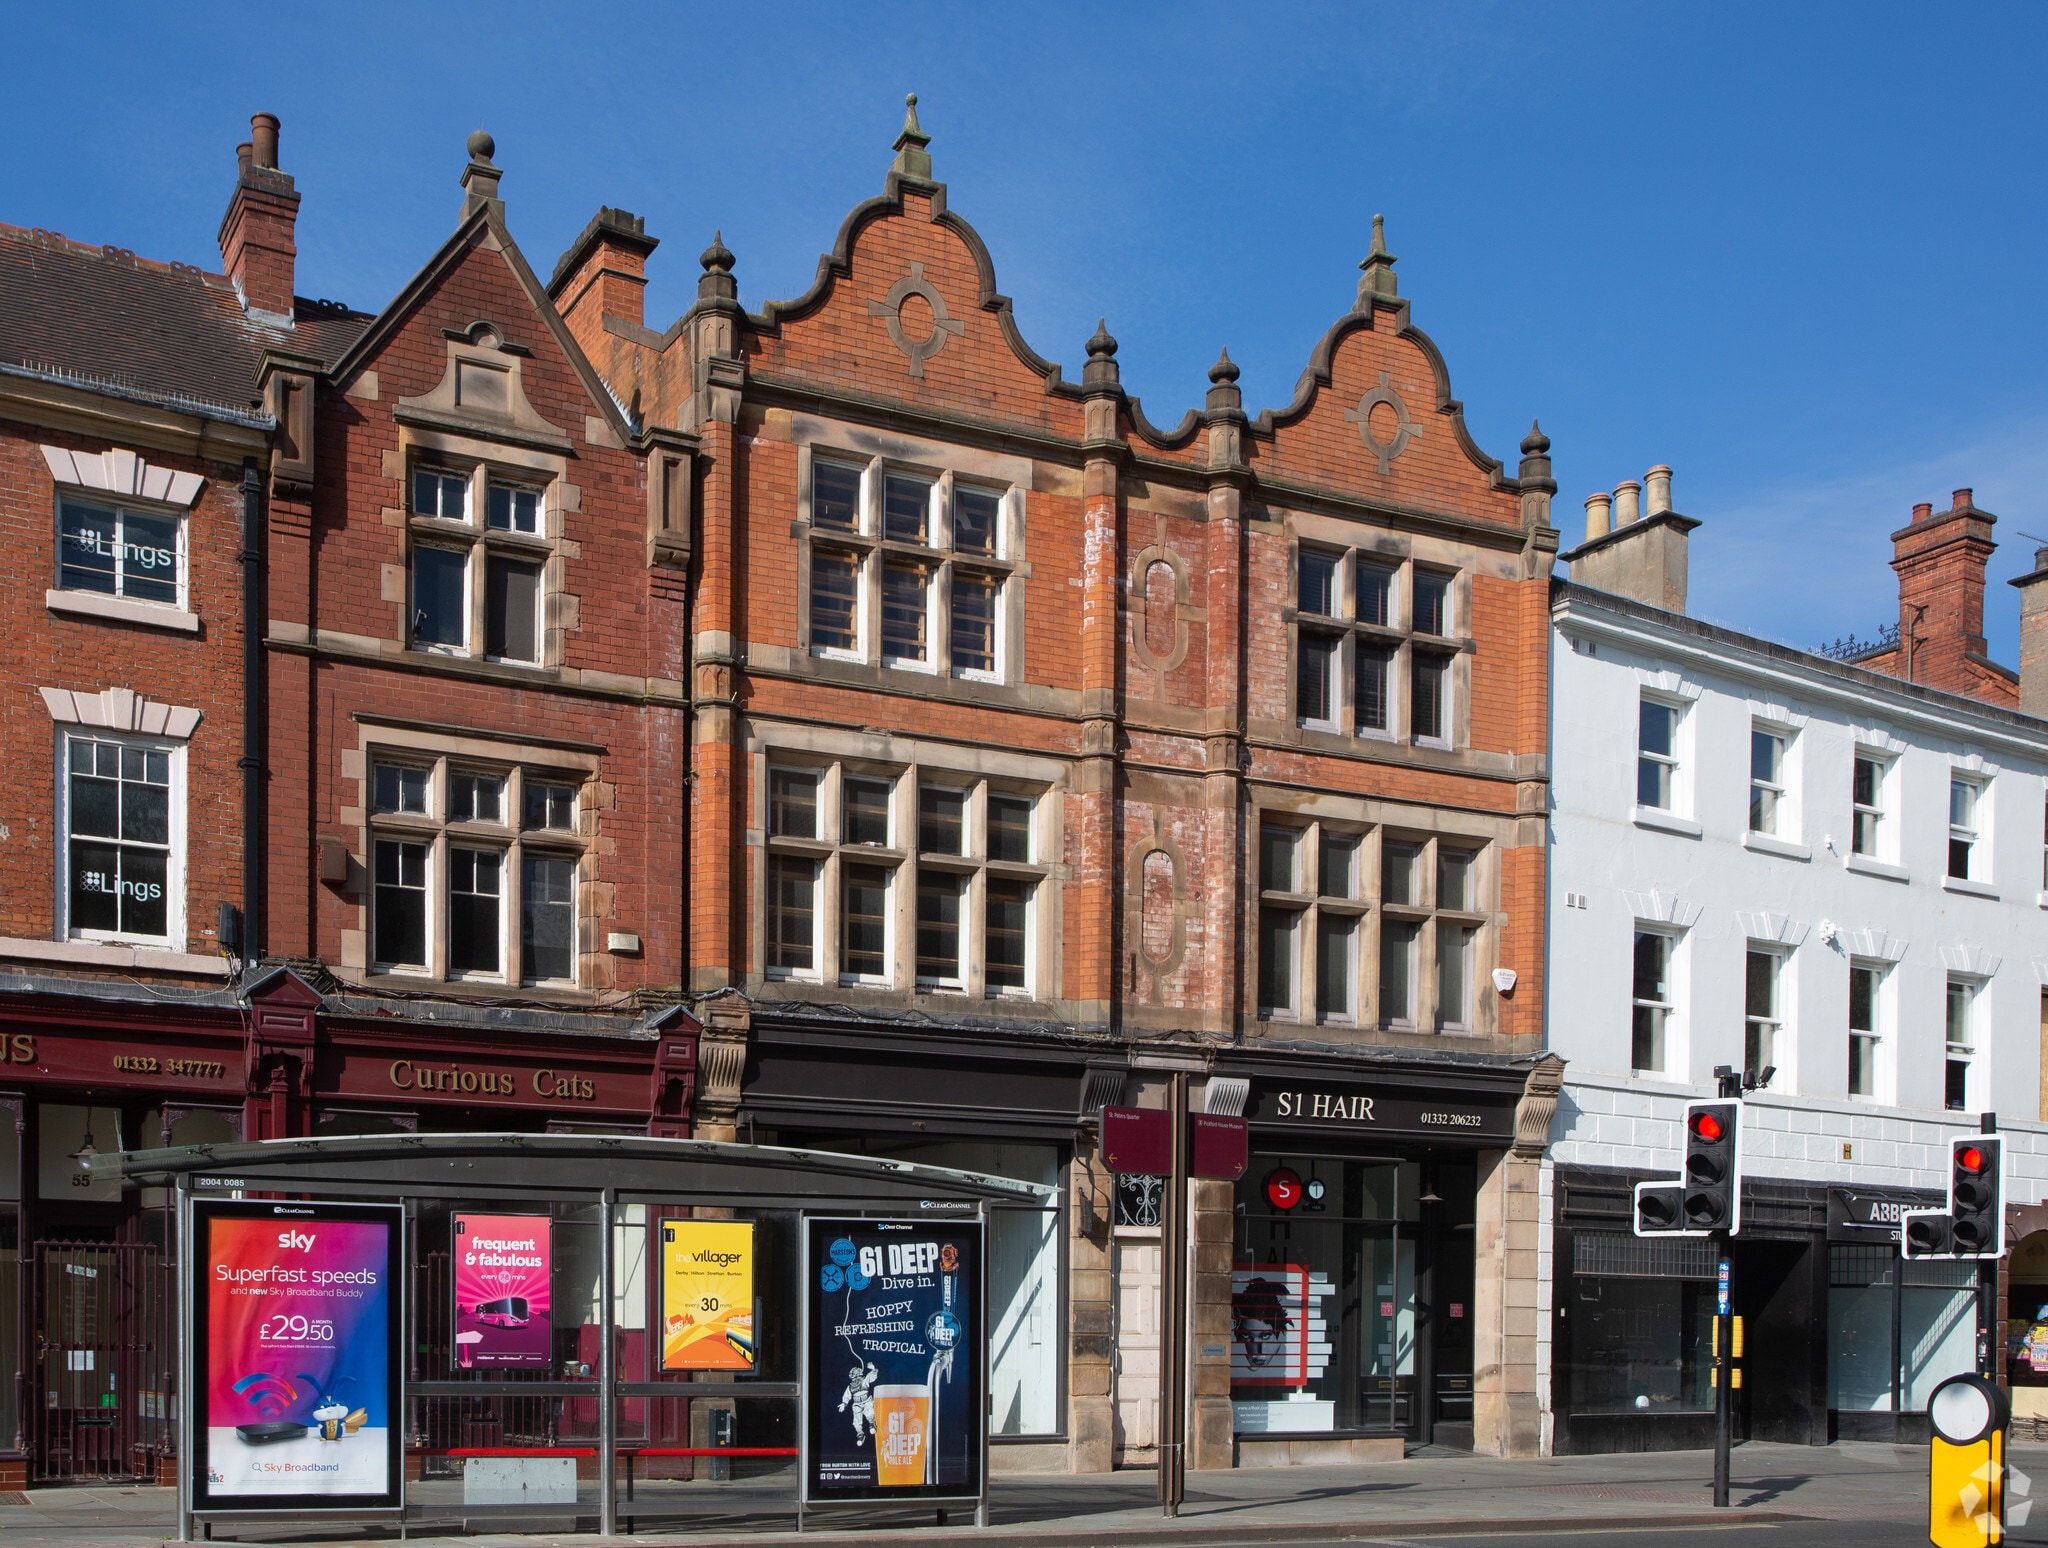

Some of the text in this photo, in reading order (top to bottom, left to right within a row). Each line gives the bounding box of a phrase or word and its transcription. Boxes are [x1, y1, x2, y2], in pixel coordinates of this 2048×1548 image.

[96, 531, 171, 569] Lings
[101, 873, 161, 902] Lings
[113, 1055, 221, 1076] 01332 347777
[389, 1060, 594, 1098] Curious Cats
[1277, 1092, 1375, 1121] S1 HAIR
[1420, 1112, 1482, 1127] 01332 206232
[72, 1174, 90, 1187] 55
[200, 1178, 245, 1187] 2004 0085
[1279, 1179, 1290, 1198] S
[1313, 1183, 1319, 1197] 1
[278, 1230, 316, 1253] sky
[472, 1236, 535, 1253] frequent
[465, 1252, 543, 1268] & fabulous
[692, 1250, 743, 1268] villager
[859, 1242, 939, 1277] 61 DEEP
[216, 1265, 377, 1287] Superfast speeds
[881, 1276, 935, 1290] Dive in.
[230, 1286, 364, 1299] and new Sky Broadband Buddy
[701, 1298, 719, 1312] 30
[865, 1300, 914, 1320] HOPPY
[260, 1315, 334, 1341] £29.50
[834, 1320, 915, 1337] REFRESHING
[935, 1316, 945, 1328] 61
[934, 1327, 955, 1341] DEEP
[862, 1339, 926, 1355] TROPICAL
[888, 1412, 905, 1434] 61
[888, 1434, 922, 1456] DEEP
[264, 1463, 339, 1473] Sky Broadband
[902, 1455, 913, 1465] ALE
